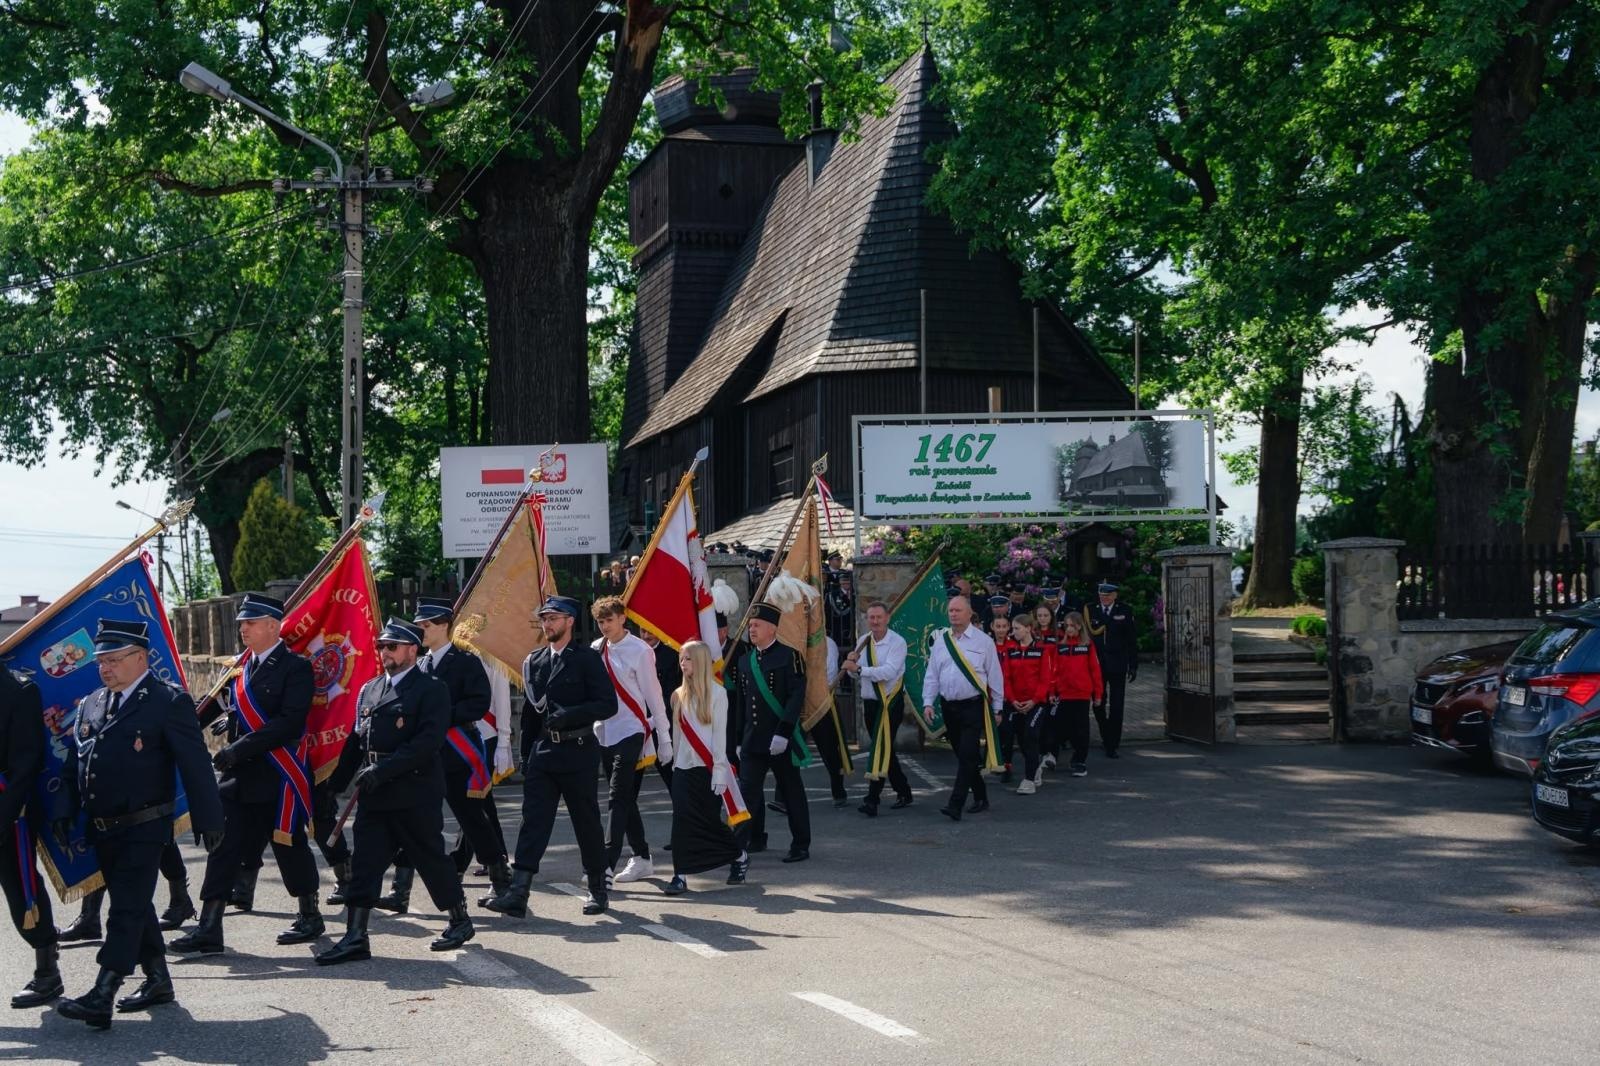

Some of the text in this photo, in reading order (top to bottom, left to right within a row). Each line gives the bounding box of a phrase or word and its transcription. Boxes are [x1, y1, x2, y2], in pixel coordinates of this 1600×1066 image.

[913, 432, 997, 463] 1467
[909, 464, 997, 478] rok powstania
[935, 481, 972, 490] Kościół
[466, 488, 524, 498] DOFINANSOWA
[544, 487, 583, 497] ŚRODKÓW
[875, 493, 928, 505] Wszystkich
[929, 491, 971, 504] Świętych
[983, 491, 1031, 502] Łaziskach
[478, 496, 571, 506] RZĄDOWE GRAMU
[543, 503, 570, 511] YTKÓW
